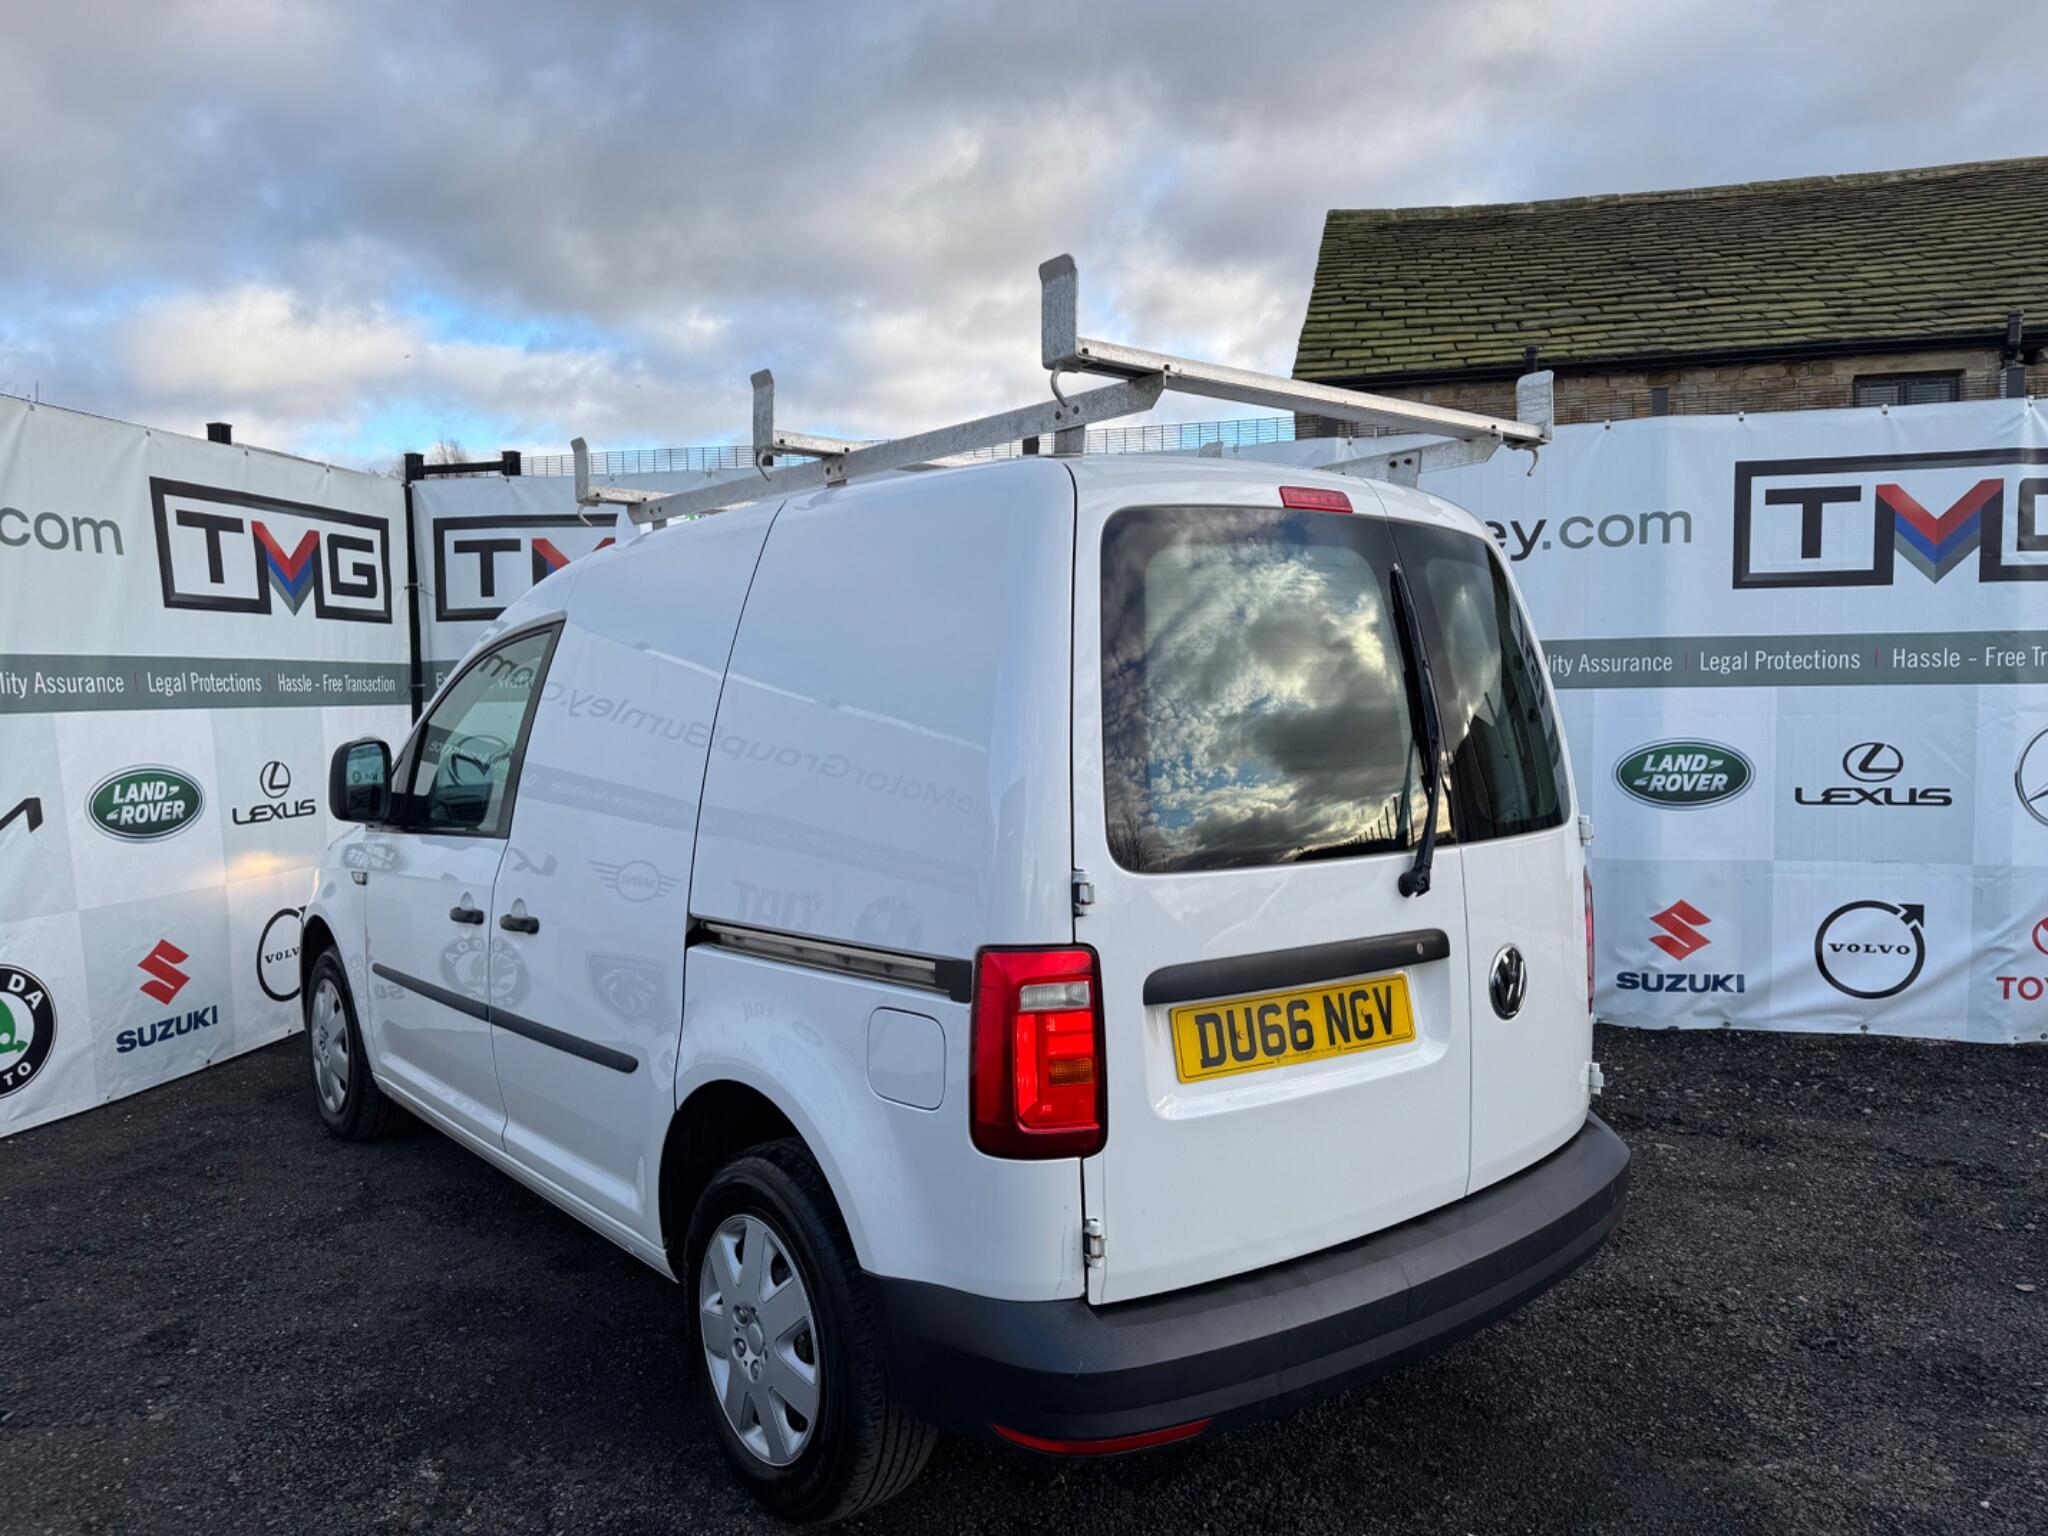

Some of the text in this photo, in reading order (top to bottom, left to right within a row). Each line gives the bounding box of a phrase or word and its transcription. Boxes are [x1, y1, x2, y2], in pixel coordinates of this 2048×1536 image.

[0, 506, 124, 555] com
[176, 508, 377, 617] TMG
[1578, 653, 1673, 673] Assurance
[1699, 650, 1748, 675] Legal
[1754, 649, 1861, 671] Protections
[1892, 647, 1961, 668] Hassle
[1985, 646, 2026, 667] Free
[34, 671, 124, 694] Assurance
[147, 672, 187, 697] Legal
[190, 672, 262, 693] Protections
[277, 673, 312, 693] Hassle
[323, 674, 343, 693] Free
[344, 674, 396, 693] Transaction
[1642, 753, 1708, 774] LAND
[111, 780, 168, 805] LAND
[1648, 772, 1730, 793] ROVER
[1794, 786, 1953, 807] LEXUS
[119, 800, 186, 826] ROVER
[231, 798, 317, 826] LEXUS
[1828, 942, 1912, 956] VOLVO
[1615, 971, 1746, 994] SUZUKI
[1995, 976, 2048, 1001] TO
[116, 1004, 219, 1055] SUZUKI
[1193, 984, 1393, 1069] DU66 NGV
